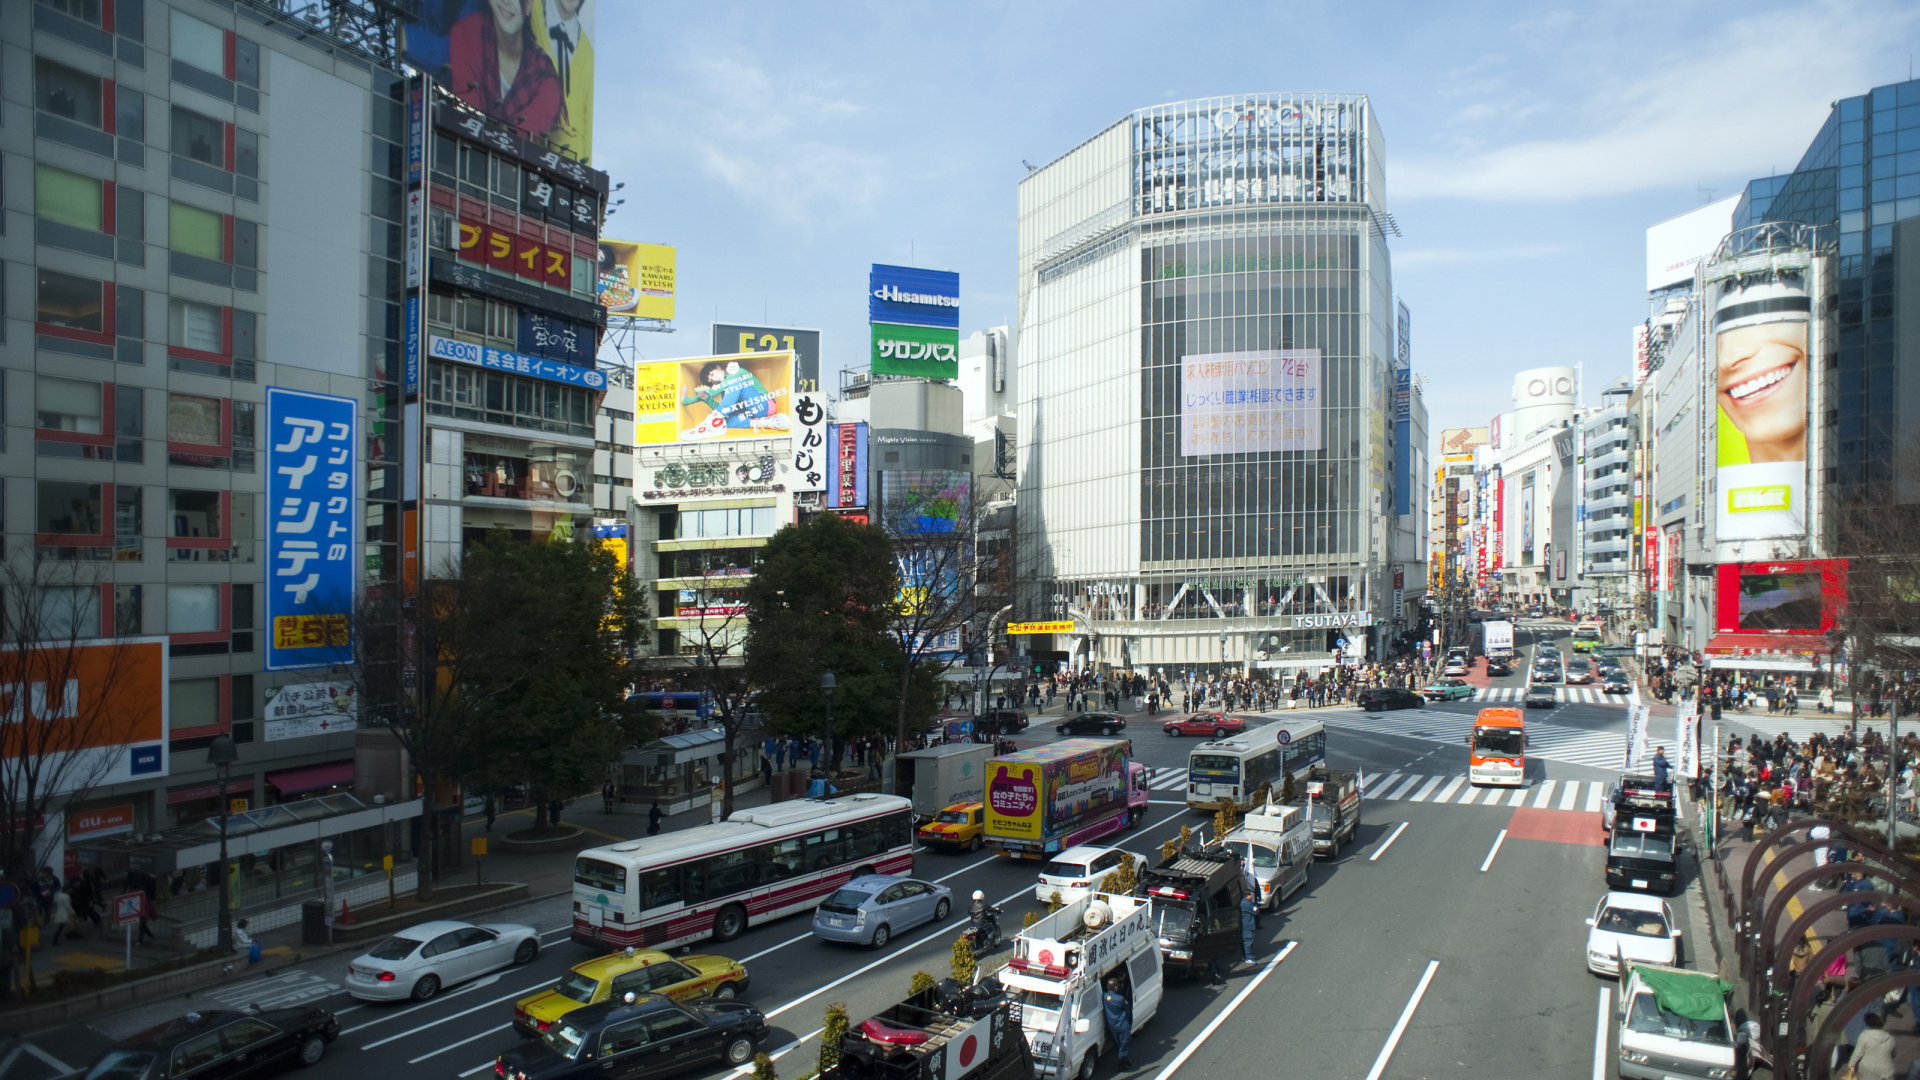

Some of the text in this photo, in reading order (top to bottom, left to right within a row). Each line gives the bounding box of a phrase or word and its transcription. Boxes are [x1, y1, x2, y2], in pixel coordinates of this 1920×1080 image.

[641, 273, 674, 281] KAWARU
[873, 284, 960, 308] Hisamitsu
[592, 309, 602, 319] 7F
[877, 339, 957, 363] サロンパス
[435, 338, 478, 361] AEON
[485, 349, 580, 382] 英会話イーオン
[587, 373, 601, 385] 6F
[721, 372, 753, 388] KAWARU
[406, 384, 418, 393] 5F
[723, 380, 755, 396] XYLISH
[638, 393, 676, 402] KAWARU
[730, 387, 788, 413] XYLISHOES
[638, 401, 676, 411] XYLISH
[795, 396, 824, 487] もんじゃ
[877, 435, 899, 444] Mighty
[900, 436, 918, 444] Vision
[327, 422, 350, 561] コンタクトの
[275, 416, 326, 604] アイシティ
[1087, 584, 1129, 596] TSUTAYA
[1188, 579, 1258, 591] STARBUCKS
[1295, 614, 1359, 628] TSUTAYA
[265, 688, 278, 698] 6F
[279, 689, 327, 702] ハチ公前
[138, 755, 155, 764] KDDI
[993, 791, 1034, 802] 女の子たちの
[80, 815, 101, 829] au
